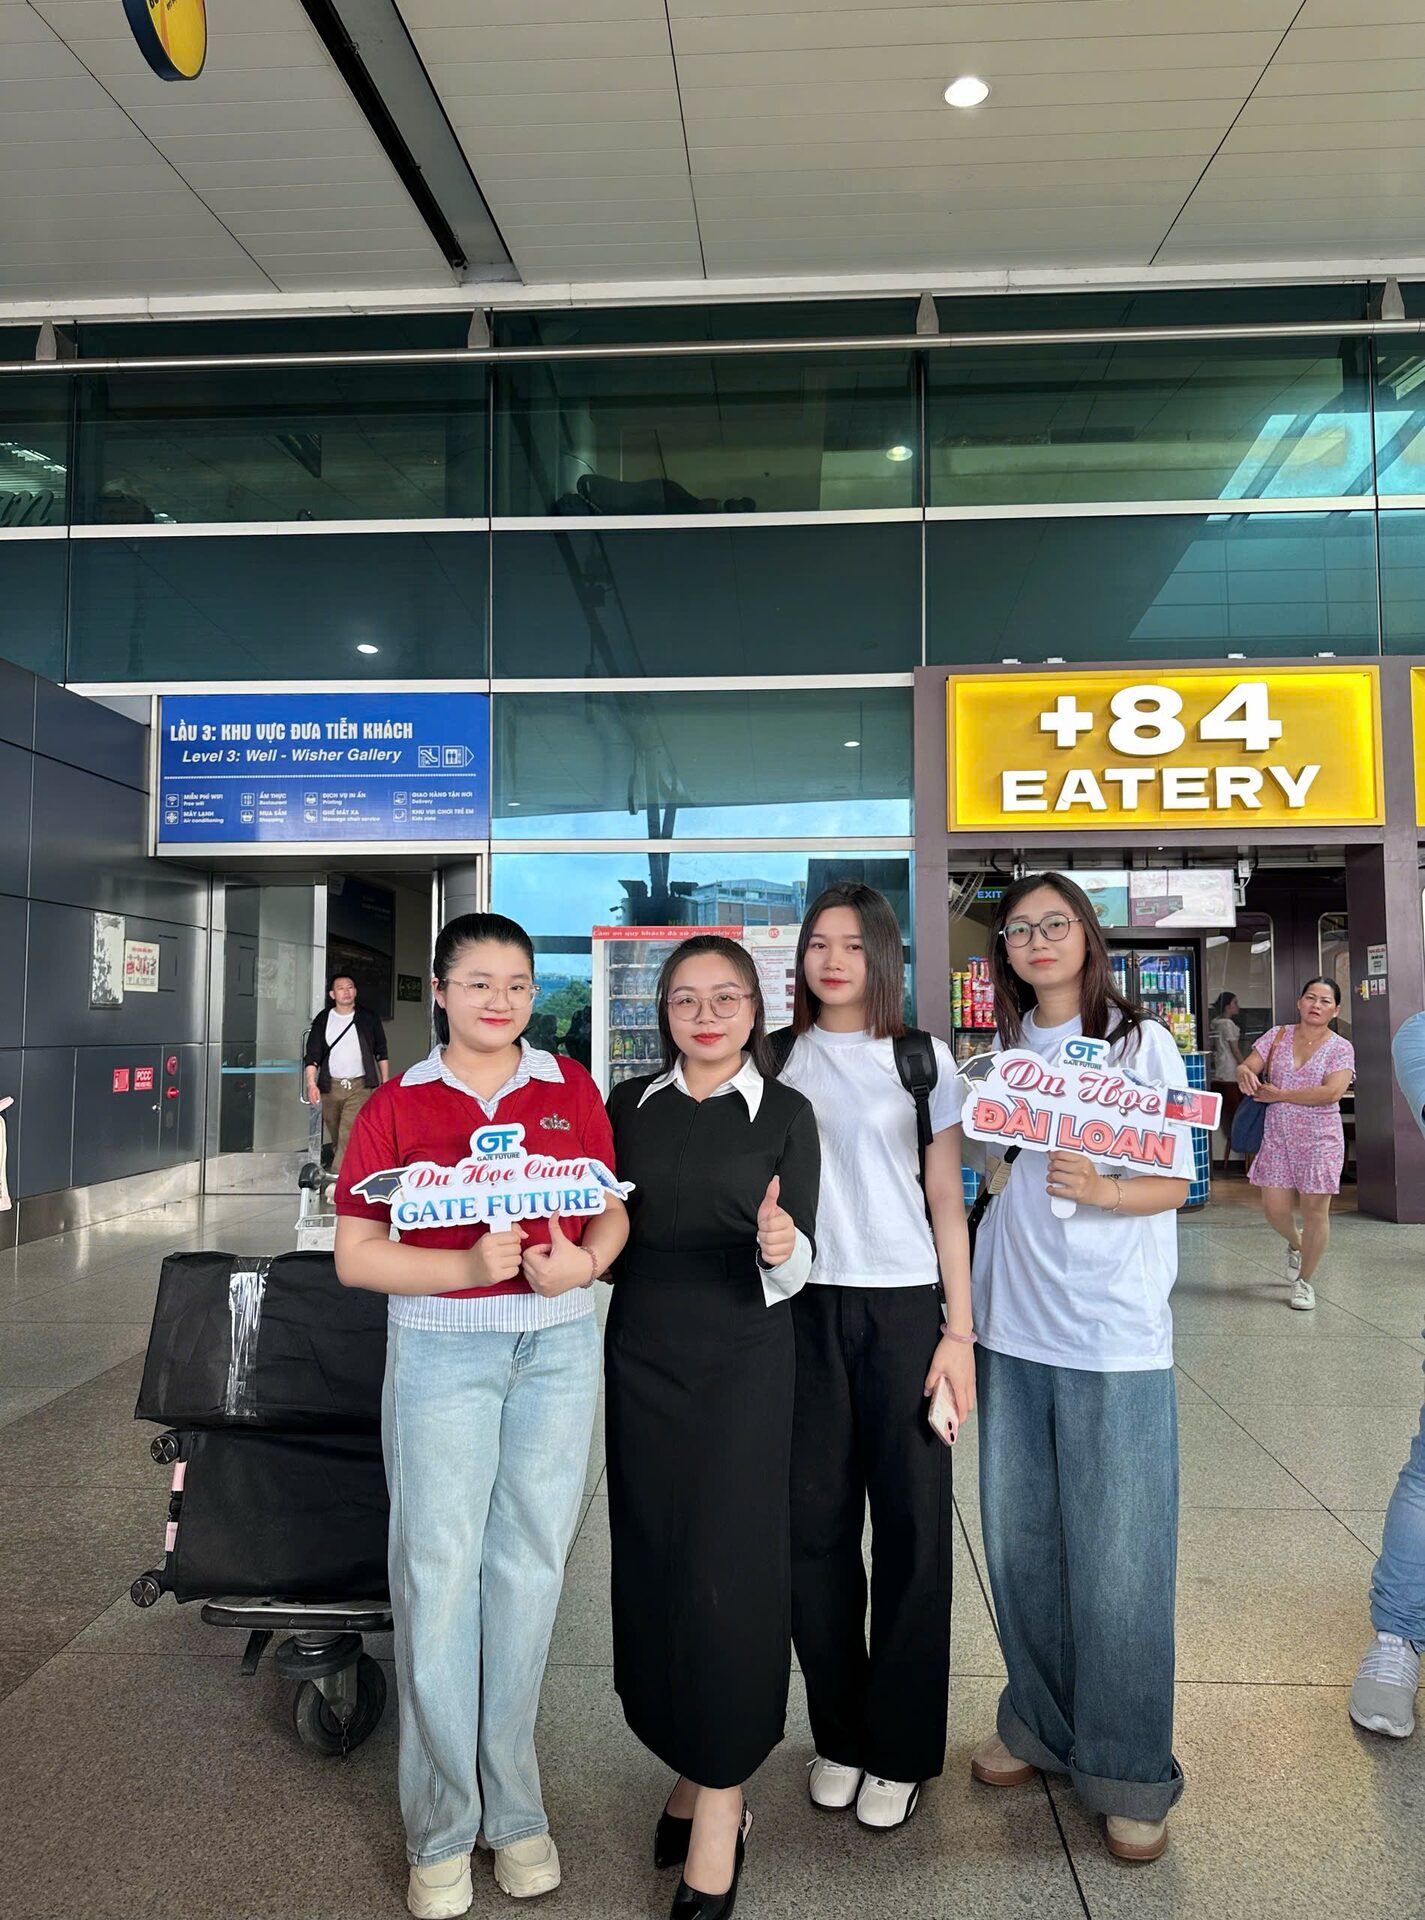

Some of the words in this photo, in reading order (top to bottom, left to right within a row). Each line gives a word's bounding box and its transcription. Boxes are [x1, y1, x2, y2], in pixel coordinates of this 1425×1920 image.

[170, 718, 198, 741] LẦU
[202, 724, 217, 741] 3:
[221, 723, 252, 741] KHU
[256, 722, 286, 744] VỰC
[290, 722, 321, 740] ĐƯA
[325, 717, 358, 740] TIỄN
[363, 719, 413, 740] KHÁCH
[1040, 682, 1283, 756] +84
[182, 749, 224, 763] Level
[226, 749, 241, 762] 3:
[246, 749, 278, 762] Well
[291, 748, 344, 762] Wisher
[347, 748, 402, 764] Gallery
[1002, 764, 1322, 812] EATERY
[977, 890, 1003, 899] EXIT
[1066, 1040, 1105, 1061] GF
[1000, 1057, 1065, 1096] Du
[1077, 1070, 1162, 1115] Học
[477, 1130, 518, 1153] GF
[972, 1094, 1053, 1145] ĐÀI
[1055, 1112, 1177, 1169] LOAN
[408, 1167, 451, 1189] Du
[461, 1162, 515, 1187] Học
[523, 1160, 588, 1181] Cùng
[397, 1196, 477, 1225] GATE
[486, 1187, 602, 1218] FUTURE
